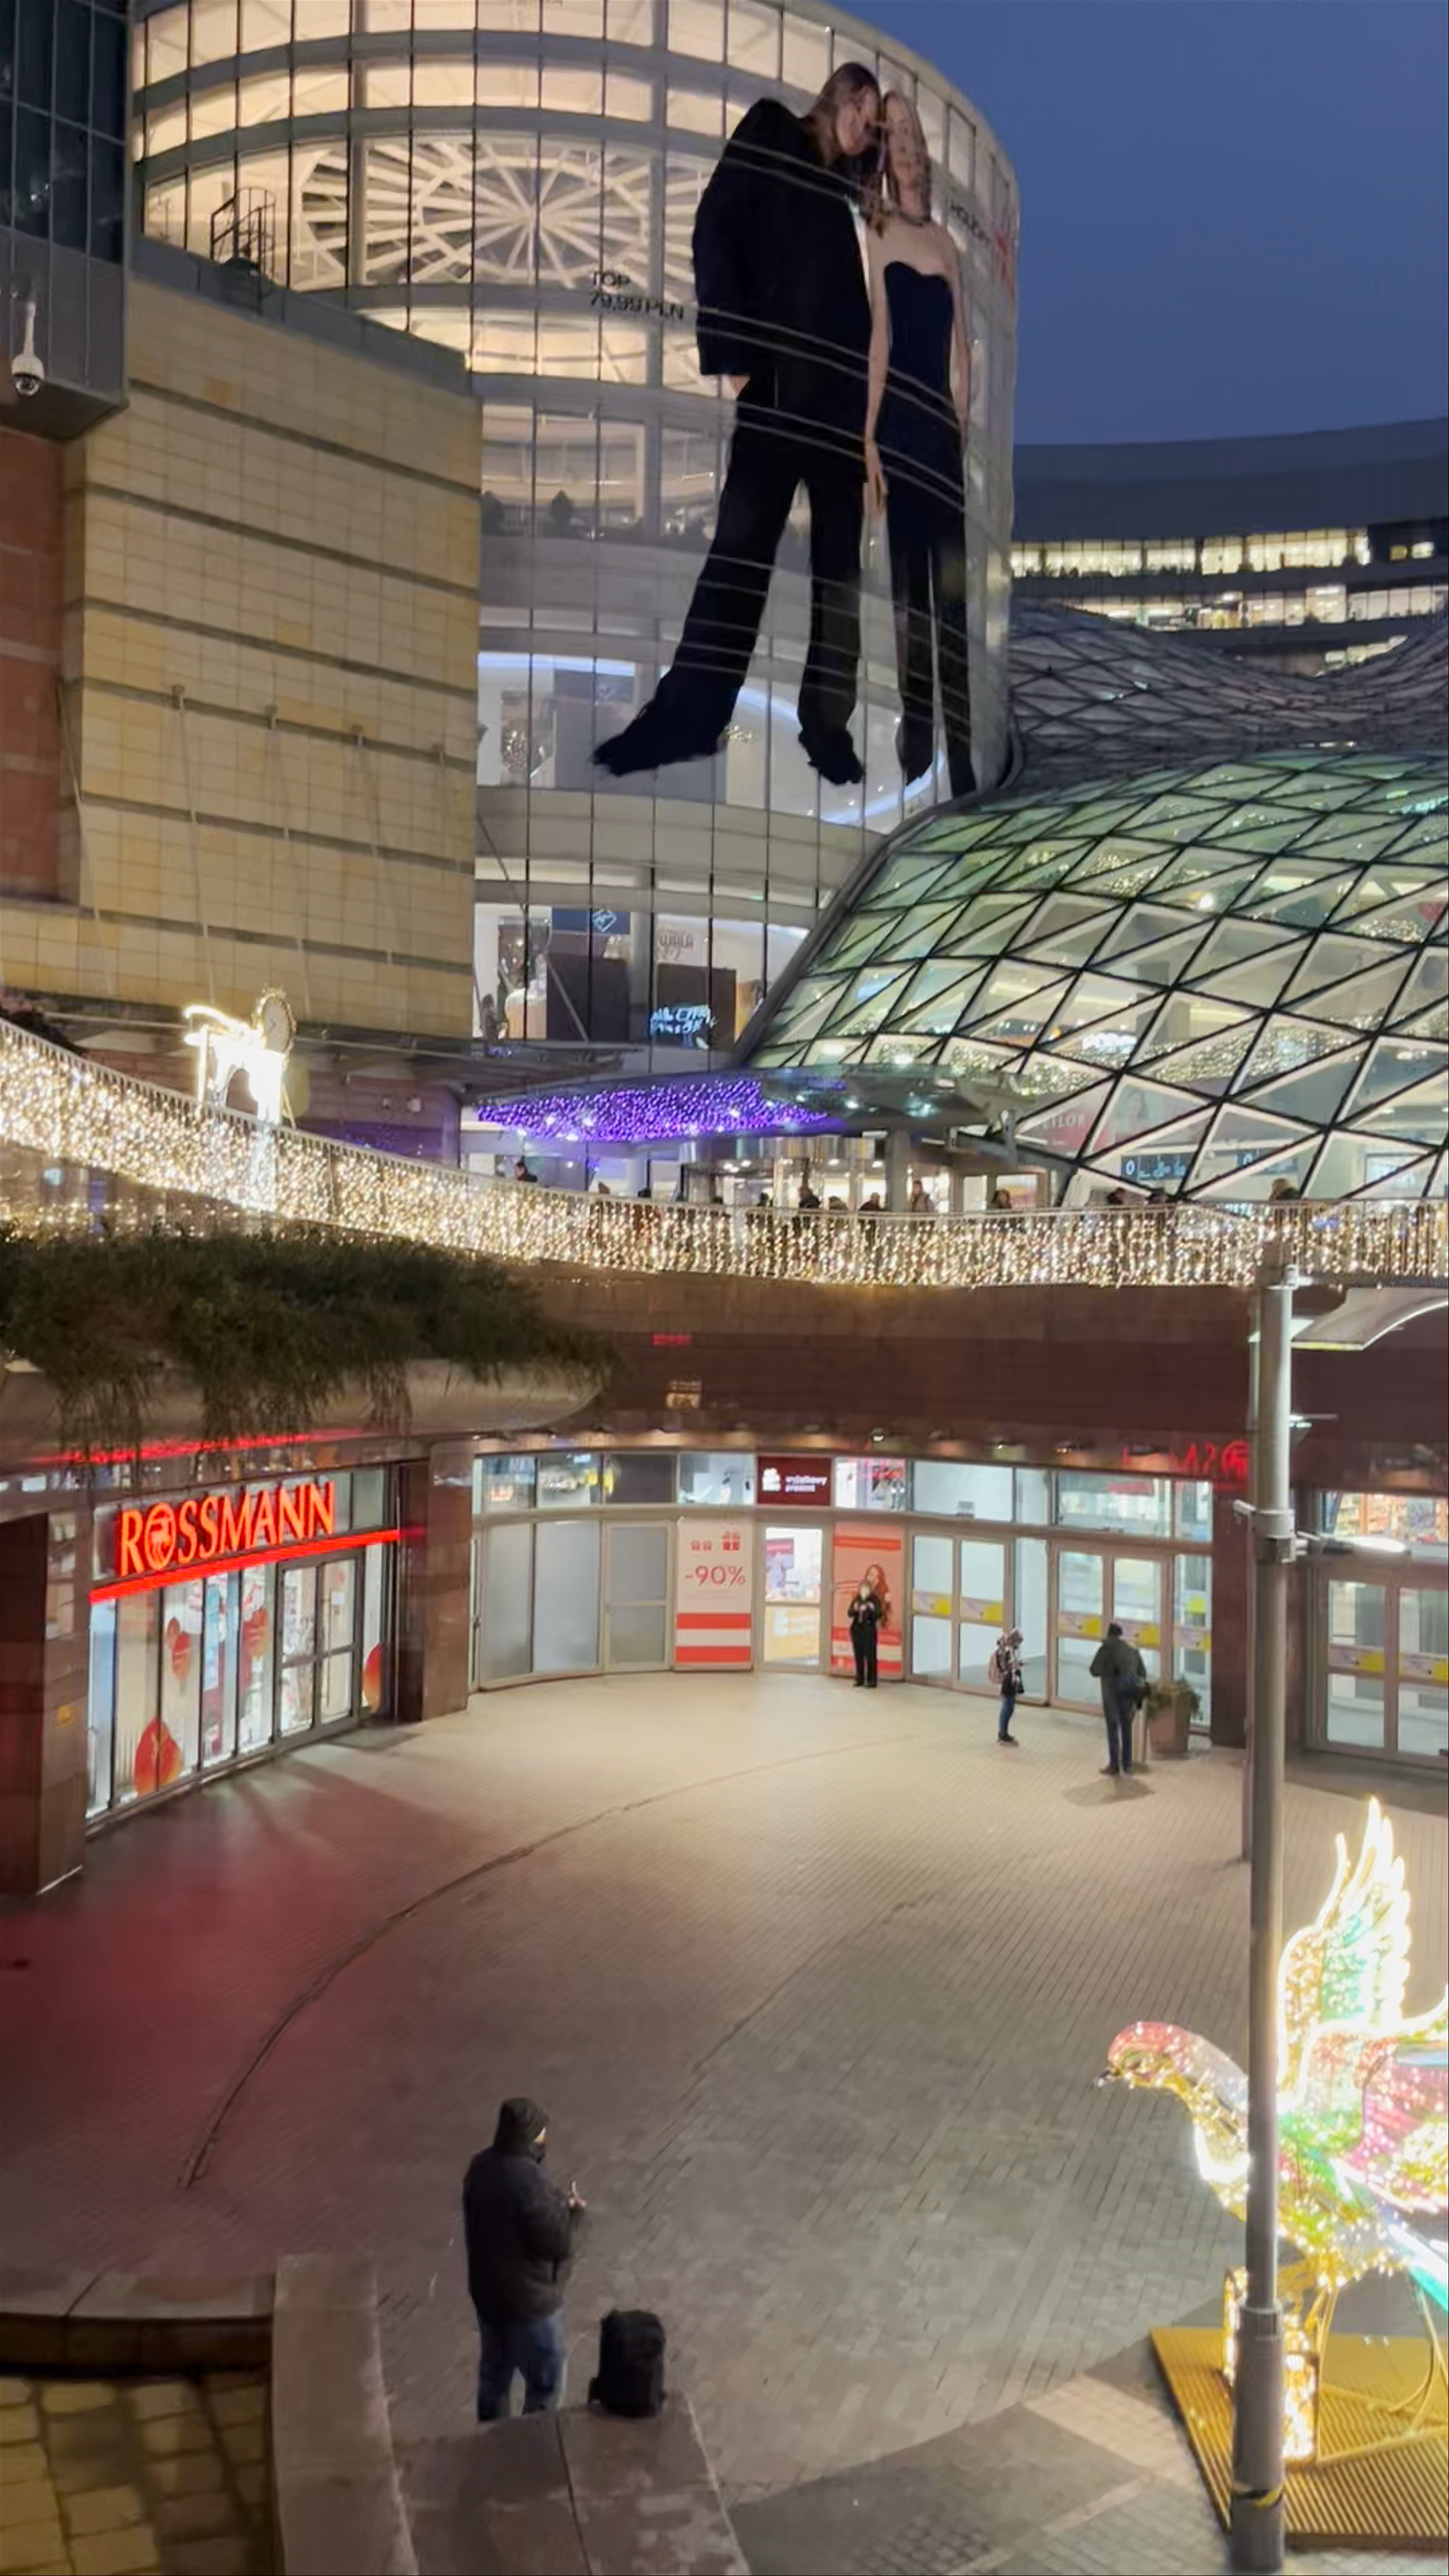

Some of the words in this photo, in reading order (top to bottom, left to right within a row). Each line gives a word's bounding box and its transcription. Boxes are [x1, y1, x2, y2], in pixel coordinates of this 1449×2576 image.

[590, 270, 631, 288] TOP
[645, 298, 684, 320] PLN
[120, 1480, 336, 1578] ROSSMANN
[685, 1565, 746, 1587] -90%
